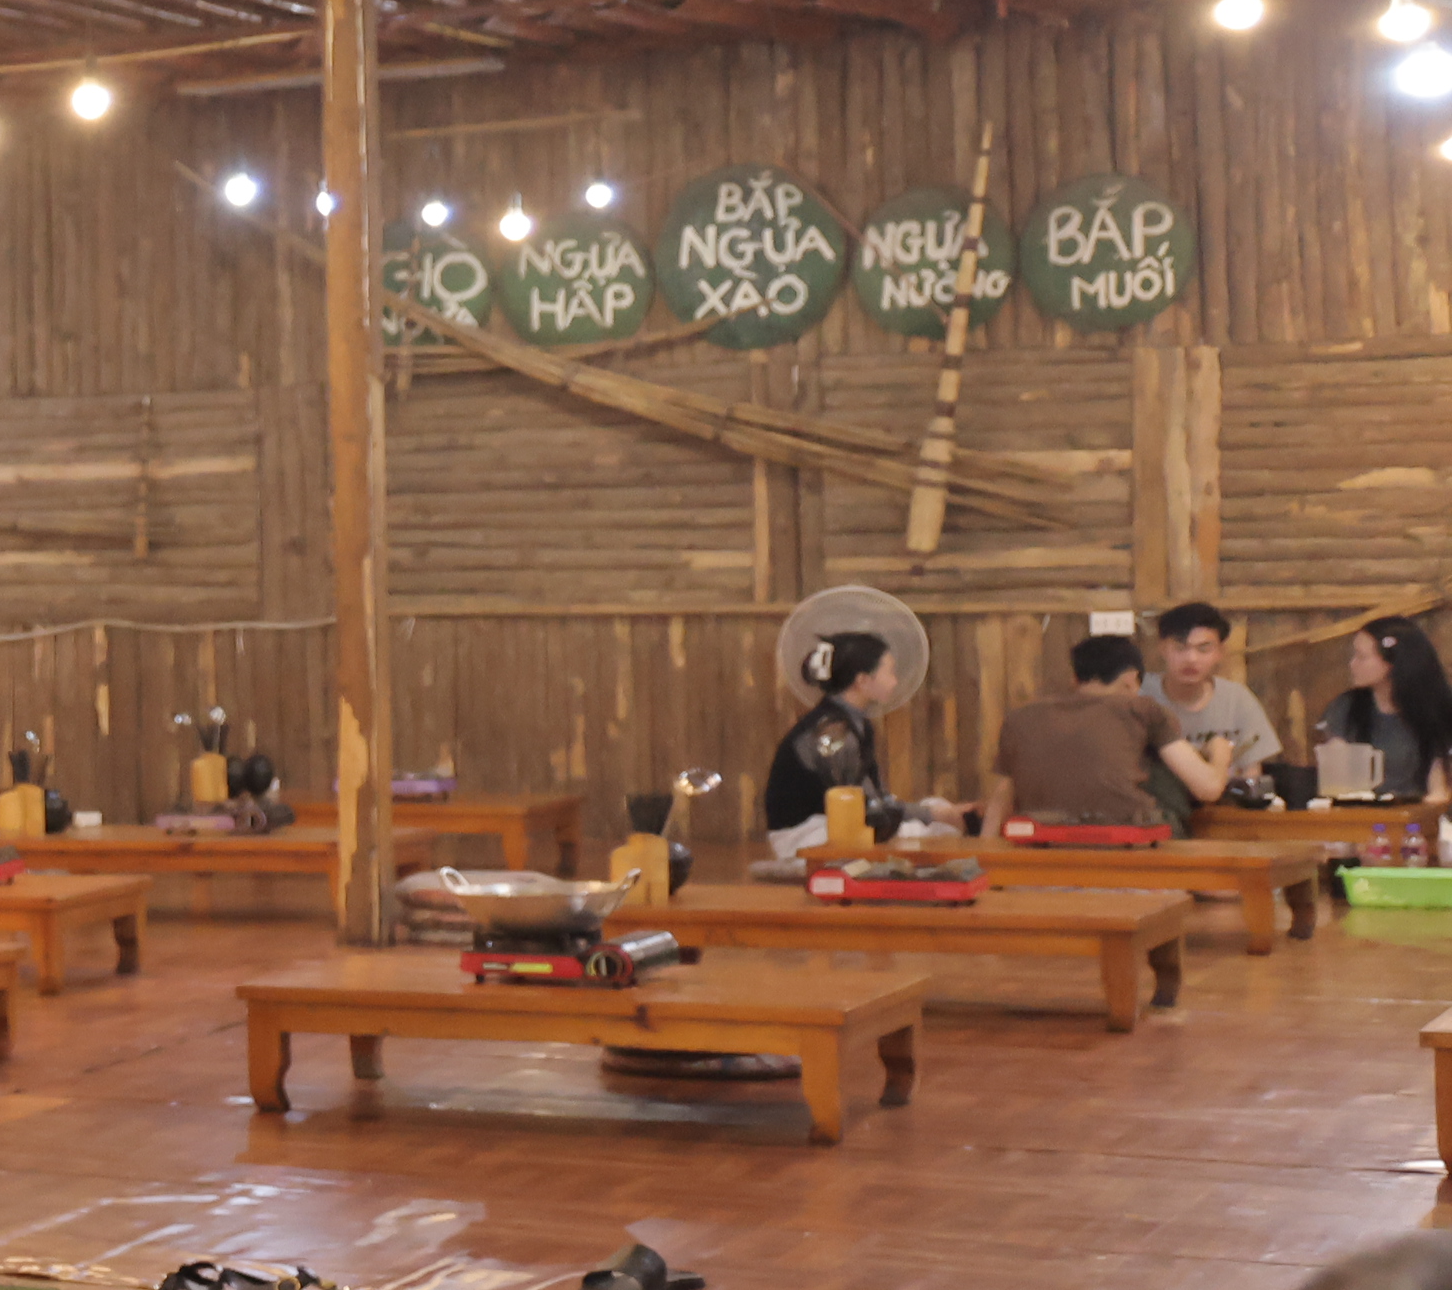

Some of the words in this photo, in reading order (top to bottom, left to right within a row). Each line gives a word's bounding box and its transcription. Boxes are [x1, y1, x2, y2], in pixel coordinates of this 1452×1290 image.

[715, 169, 804, 227] BẮP
[1047, 182, 1175, 265] BẮP
[678, 216, 837, 273] NGỰA
[1071, 240, 1176, 311] MUỐI
